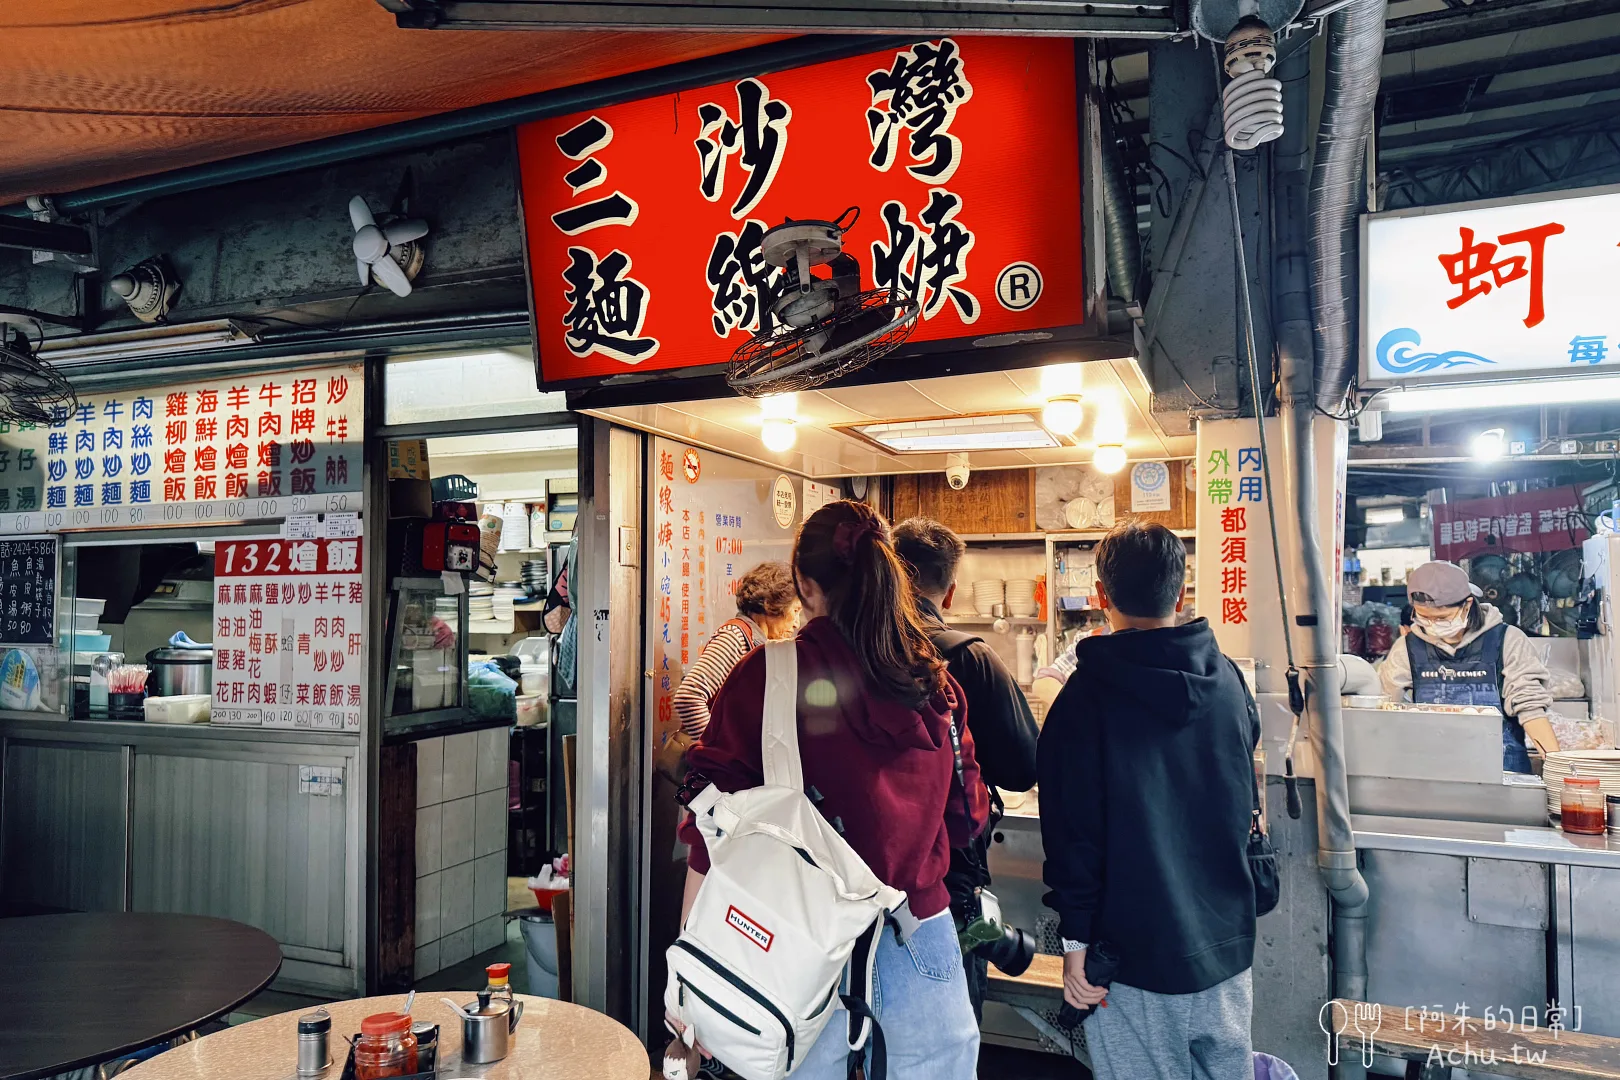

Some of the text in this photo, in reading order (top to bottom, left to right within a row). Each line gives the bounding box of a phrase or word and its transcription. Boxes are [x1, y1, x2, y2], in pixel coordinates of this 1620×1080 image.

[73, 402, 96, 507] 羊肉炒麵
[101, 399, 124, 505] 牛肉炒麵
[130, 396, 153, 504] 肉絲炒麵
[163, 392, 188, 502] 雞柳燴飯
[194, 389, 219, 500] 海鮮燴飯
[225, 385, 250, 498] 羊肉燴飯
[257, 382, 282, 496] 牛肉燴飯
[290, 379, 317, 495] 招牌炒飯
[1207, 448, 1233, 504] 外帶
[1237, 446, 1263, 502] 內用
[100, 508, 119, 523] 100
[163, 504, 183, 519] 100
[194, 503, 213, 519] 100
[224, 502, 245, 518] 100
[257, 500, 278, 515] 100
[325, 495, 348, 511] 150
[715, 535, 743, 555] 07:00
[1221, 506, 1248, 625] 都須排隊
[216, 583, 231, 703] 麻油腰花
[231, 583, 247, 703] 麻油豬肝
[296, 582, 312, 705] 炒青菜
[313, 582, 329, 706] 羊肉炒飯
[329, 582, 345, 706] 牛肉炒飯
[347, 581, 362, 707] 豬肝湯
[263, 711, 276, 722] 160
[730, 913, 768, 944] HUNTER
